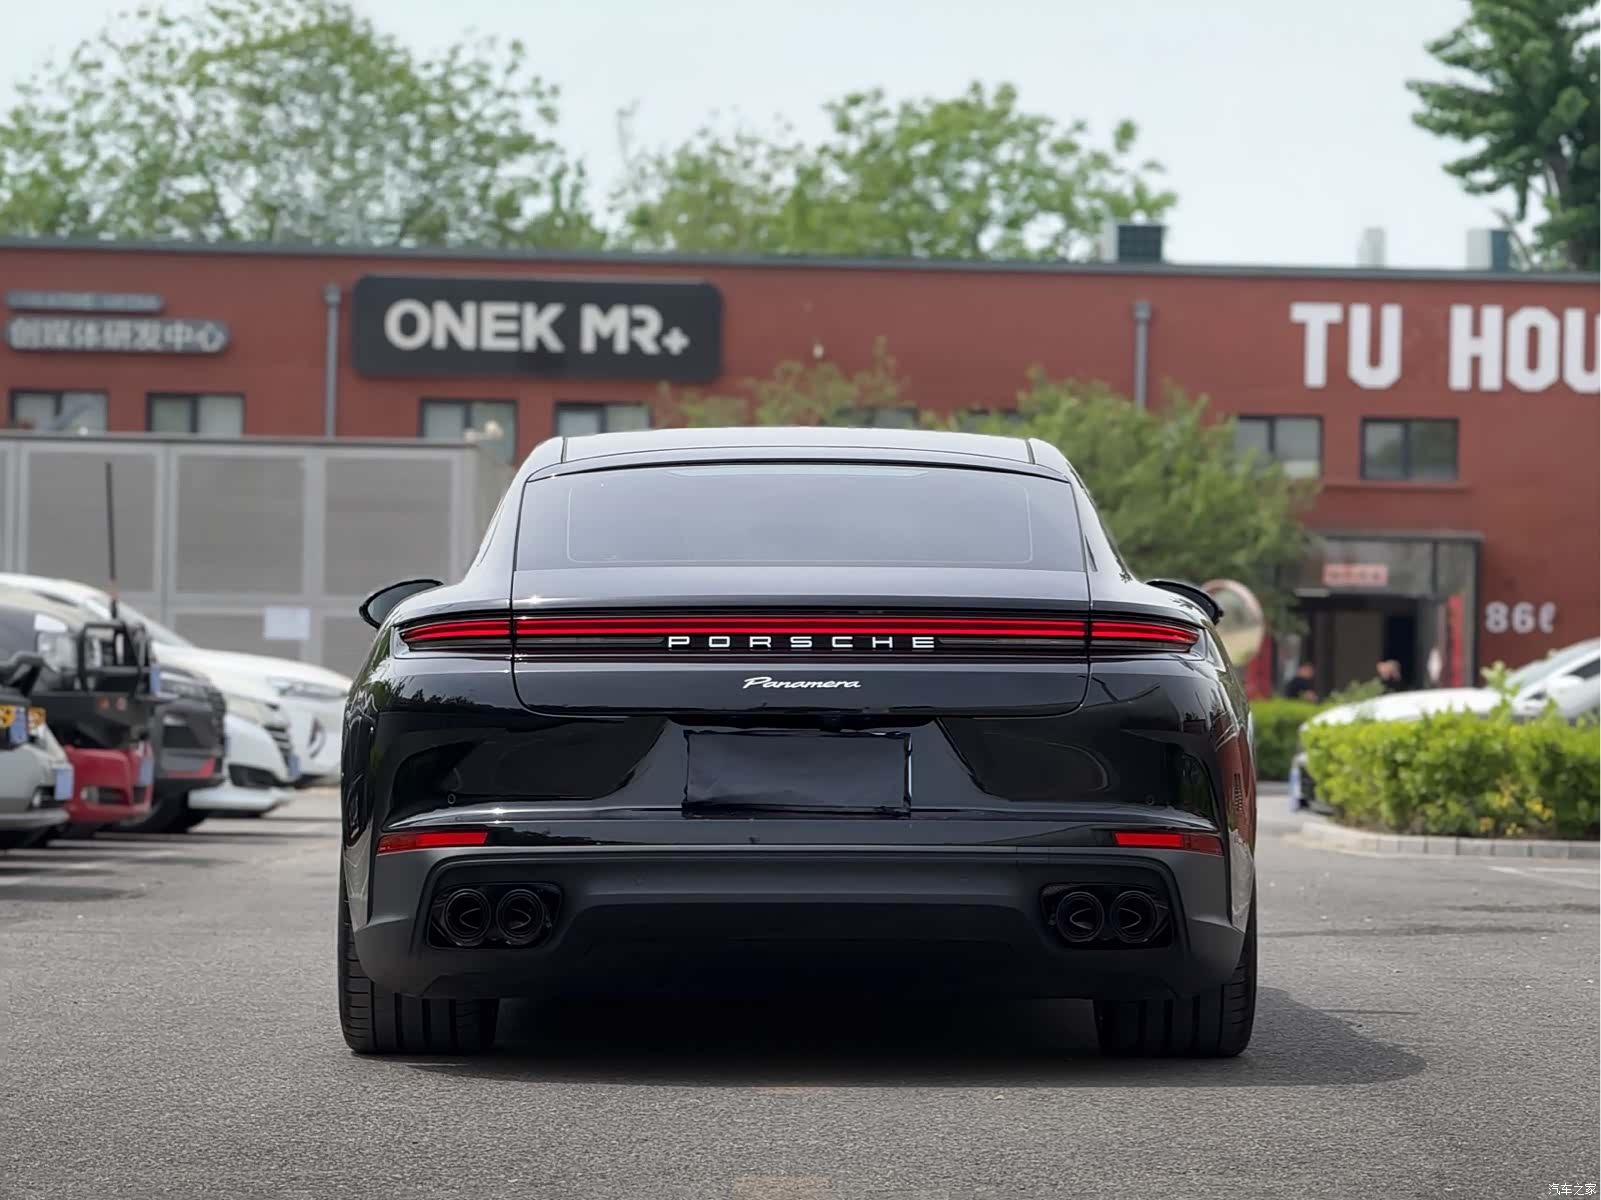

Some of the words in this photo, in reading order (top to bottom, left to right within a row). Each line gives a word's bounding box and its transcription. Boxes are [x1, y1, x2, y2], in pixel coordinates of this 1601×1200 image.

[384, 298, 565, 353] ONEK
[1290, 301, 1403, 390] TU
[667, 635, 935, 649] PORSCHE
[742, 676, 862, 690] Panamera
